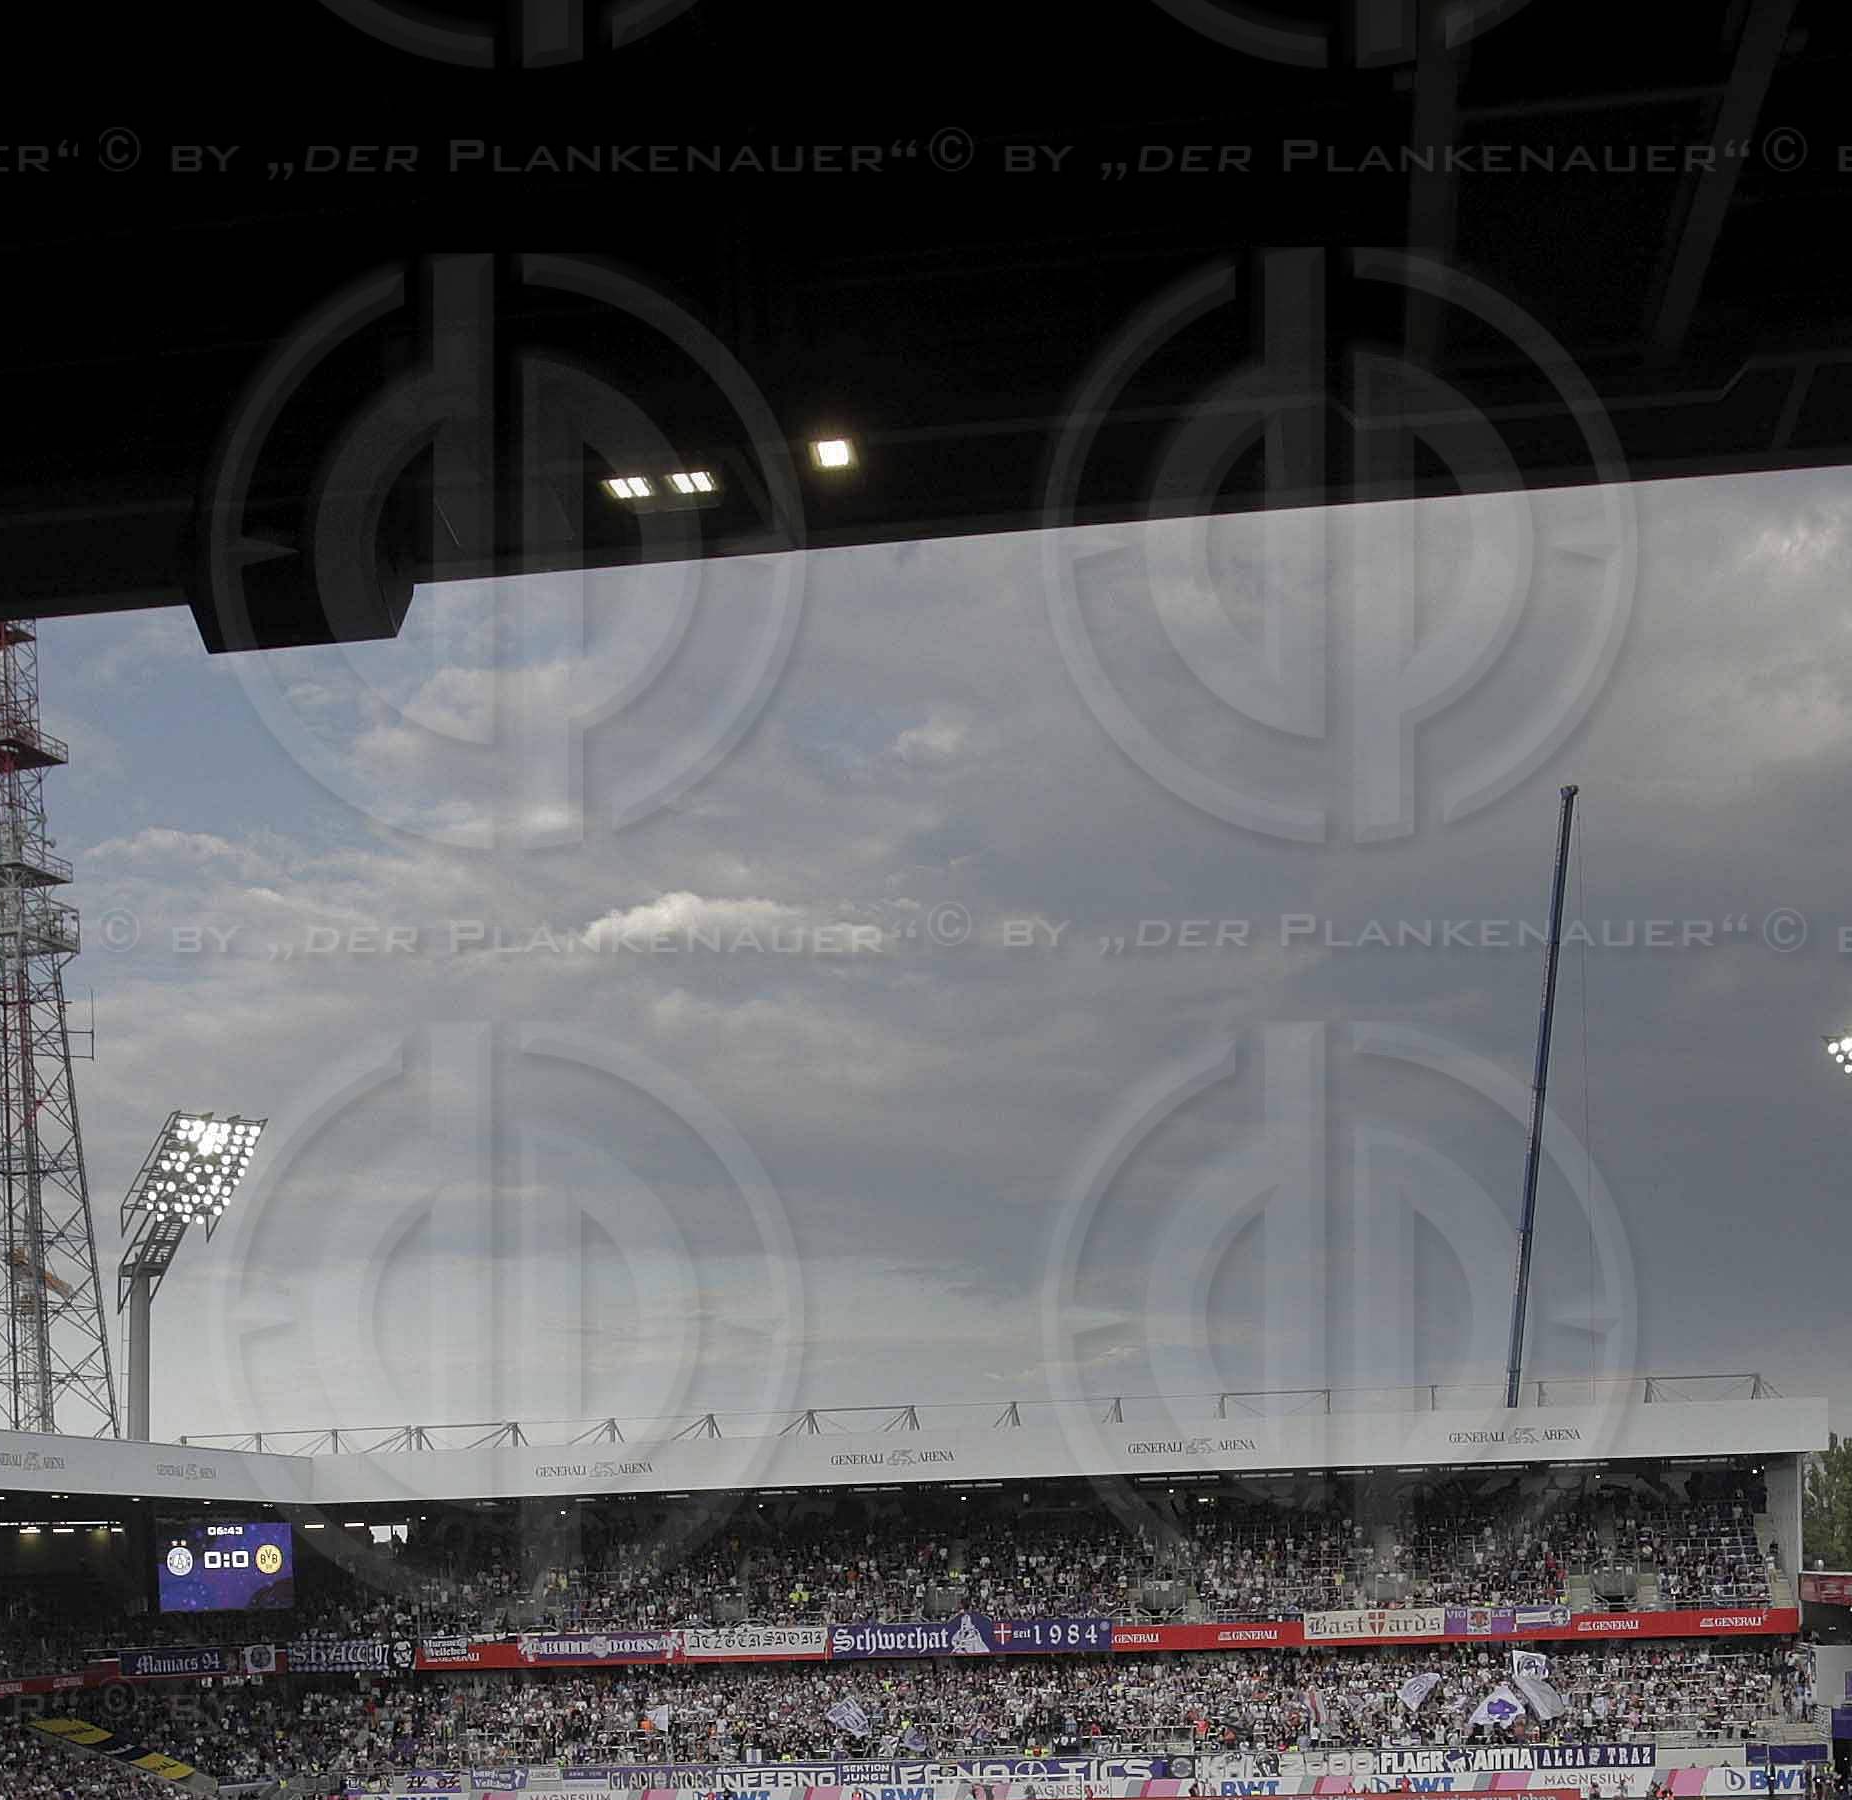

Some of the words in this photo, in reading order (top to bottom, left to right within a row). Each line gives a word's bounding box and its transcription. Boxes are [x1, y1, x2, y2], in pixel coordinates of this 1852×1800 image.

[1448, 1430, 1505, 1445] GENERALI
[1542, 1427, 1581, 1442] ARENA
[1127, 1441, 1183, 1455] GENERALI
[1218, 1439, 1256, 1452] ARENA
[830, 1454, 885, 1468] GENERALI
[918, 1450, 955, 1464] ARENA
[535, 1465, 587, 1479] GENERALI
[618, 1462, 652, 1476] ARENA
[1592, 1619, 1640, 1631] GENERALI
[1715, 1616, 1763, 1628] GENERALI
[833, 1624, 949, 1654] Schwechat
[1012, 1629, 1031, 1641] seit
[1034, 1622, 1099, 1646] 1984
[1231, 1630, 1278, 1642] GENERALI
[841, 1774, 888, 1784] JUNGE
